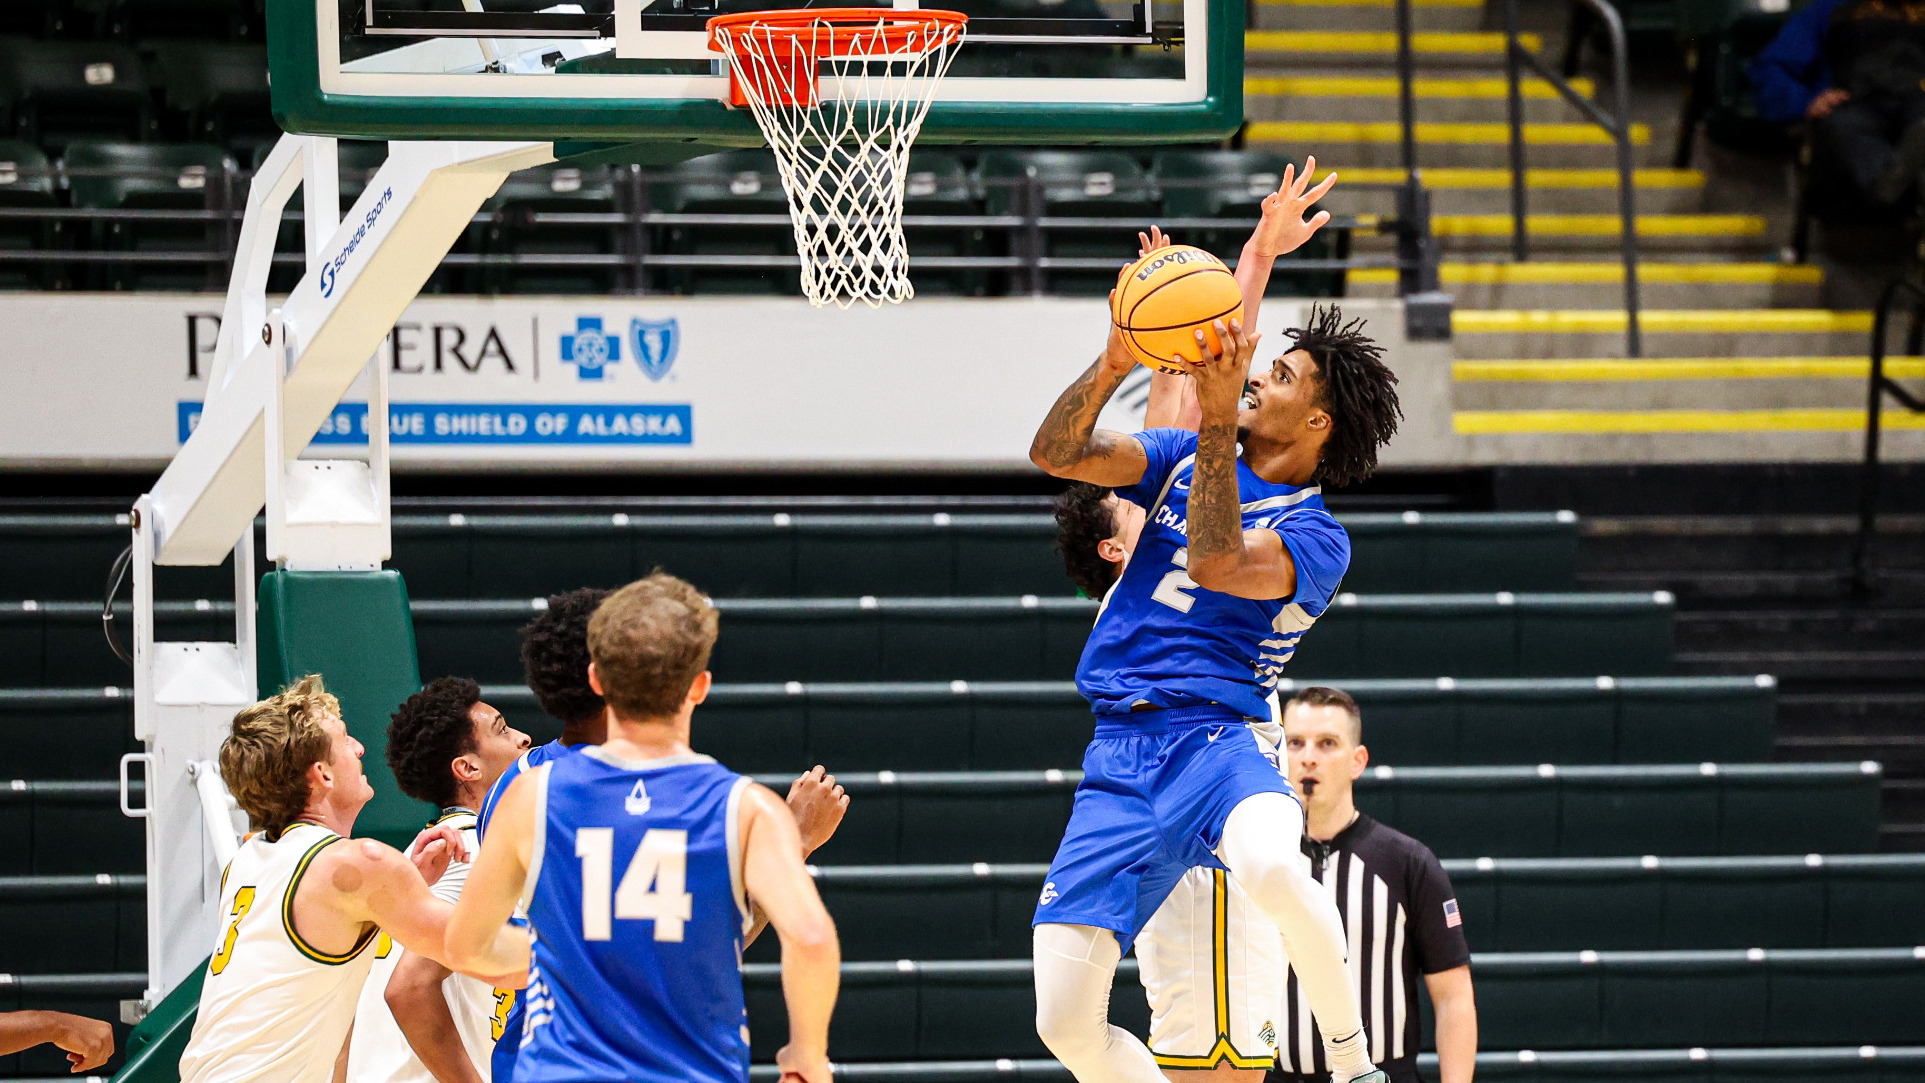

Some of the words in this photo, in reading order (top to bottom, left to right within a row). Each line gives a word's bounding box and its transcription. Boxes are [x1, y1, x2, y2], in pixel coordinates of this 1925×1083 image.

[366, 186, 393, 229] Sports
[433, 412, 528, 436] SHIELD
[534, 412, 569, 436] OF
[576, 412, 683, 437] ALASKA
[1150, 546, 1201, 614] 2
[575, 826, 693, 943] 14
[210, 885, 257, 976] 3
